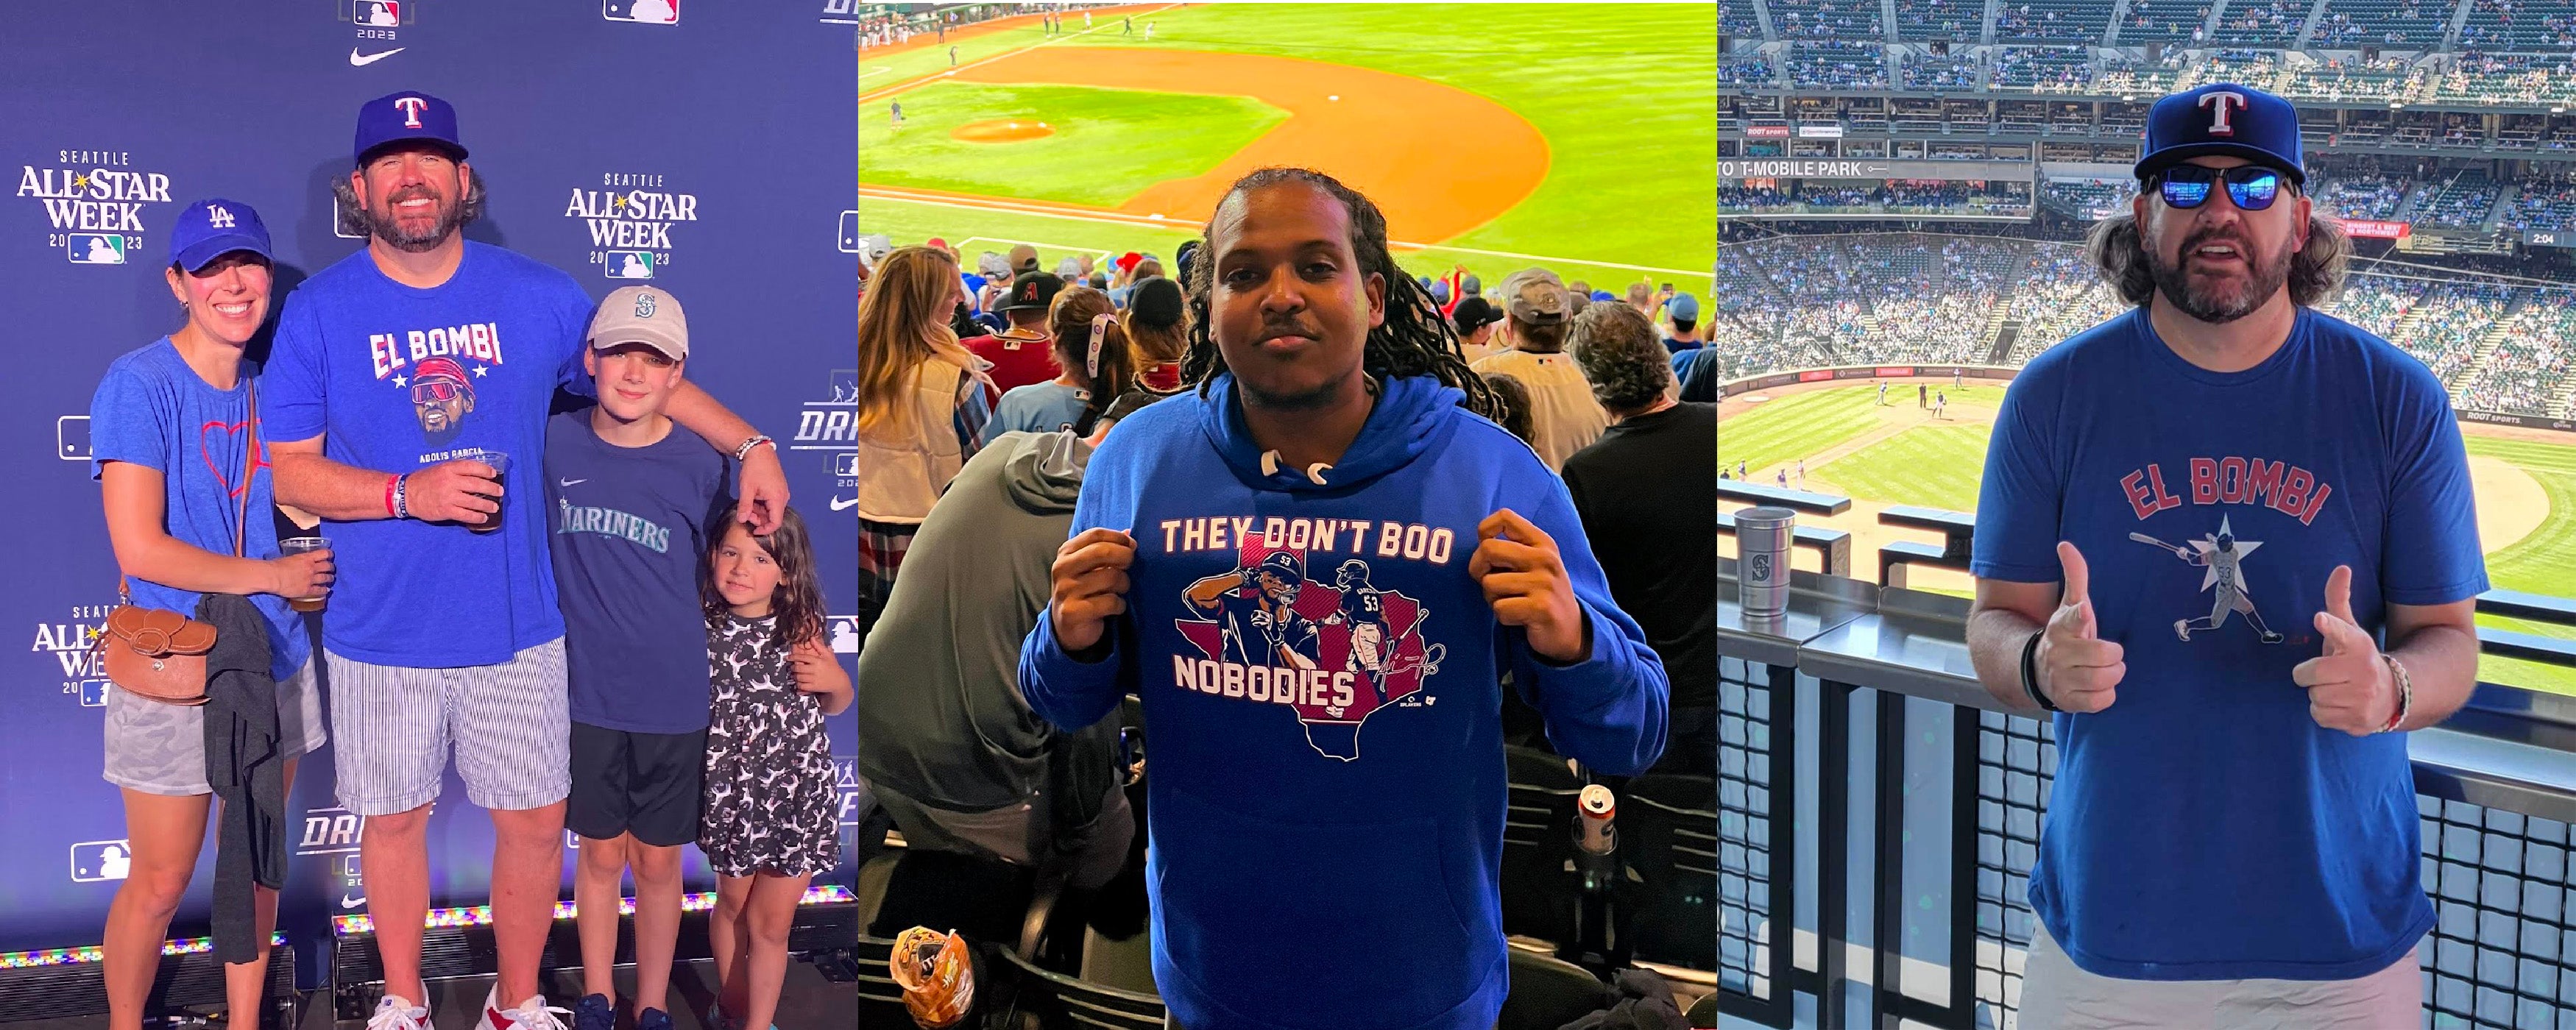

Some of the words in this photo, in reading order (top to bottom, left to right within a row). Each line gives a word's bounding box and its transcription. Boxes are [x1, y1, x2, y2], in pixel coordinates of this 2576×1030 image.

[357, 29, 395, 40] 2023
[395, 97, 428, 128] T
[2198, 91, 2248, 137] T
[60, 149, 129, 166] SEATTLE
[1740, 161, 1814, 177] T-MOBILE
[1818, 161, 1861, 177] PARK
[604, 172, 663, 187] SEATTLE
[42, 198, 145, 232] WEEK
[206, 204, 236, 228] LA
[49, 233, 65, 247] 20
[127, 236, 142, 250] 23
[587, 219, 673, 249] WEEK
[2533, 233, 2554, 244] 2:04
[590, 251, 604, 264] 20
[656, 252, 670, 266] 23
[635, 294, 657, 319] S
[369, 333, 406, 380] EL
[407, 322, 503, 366] BOMBI
[2466, 412, 2492, 422] ROOT
[419, 451, 449, 464] ADOLIS
[2120, 464, 2182, 521] EL
[2190, 456, 2332, 526] BOMBI
[1161, 516, 1254, 553] THEY
[1262, 516, 1370, 553] DON'T
[1377, 522, 1454, 565] BOO
[1280, 555, 1291, 566] 53
[1752, 554, 1770, 581] S
[1364, 595, 1379, 611] 53
[63, 682, 78, 694] 20
[1174, 656, 1355, 706] NOBODIES
